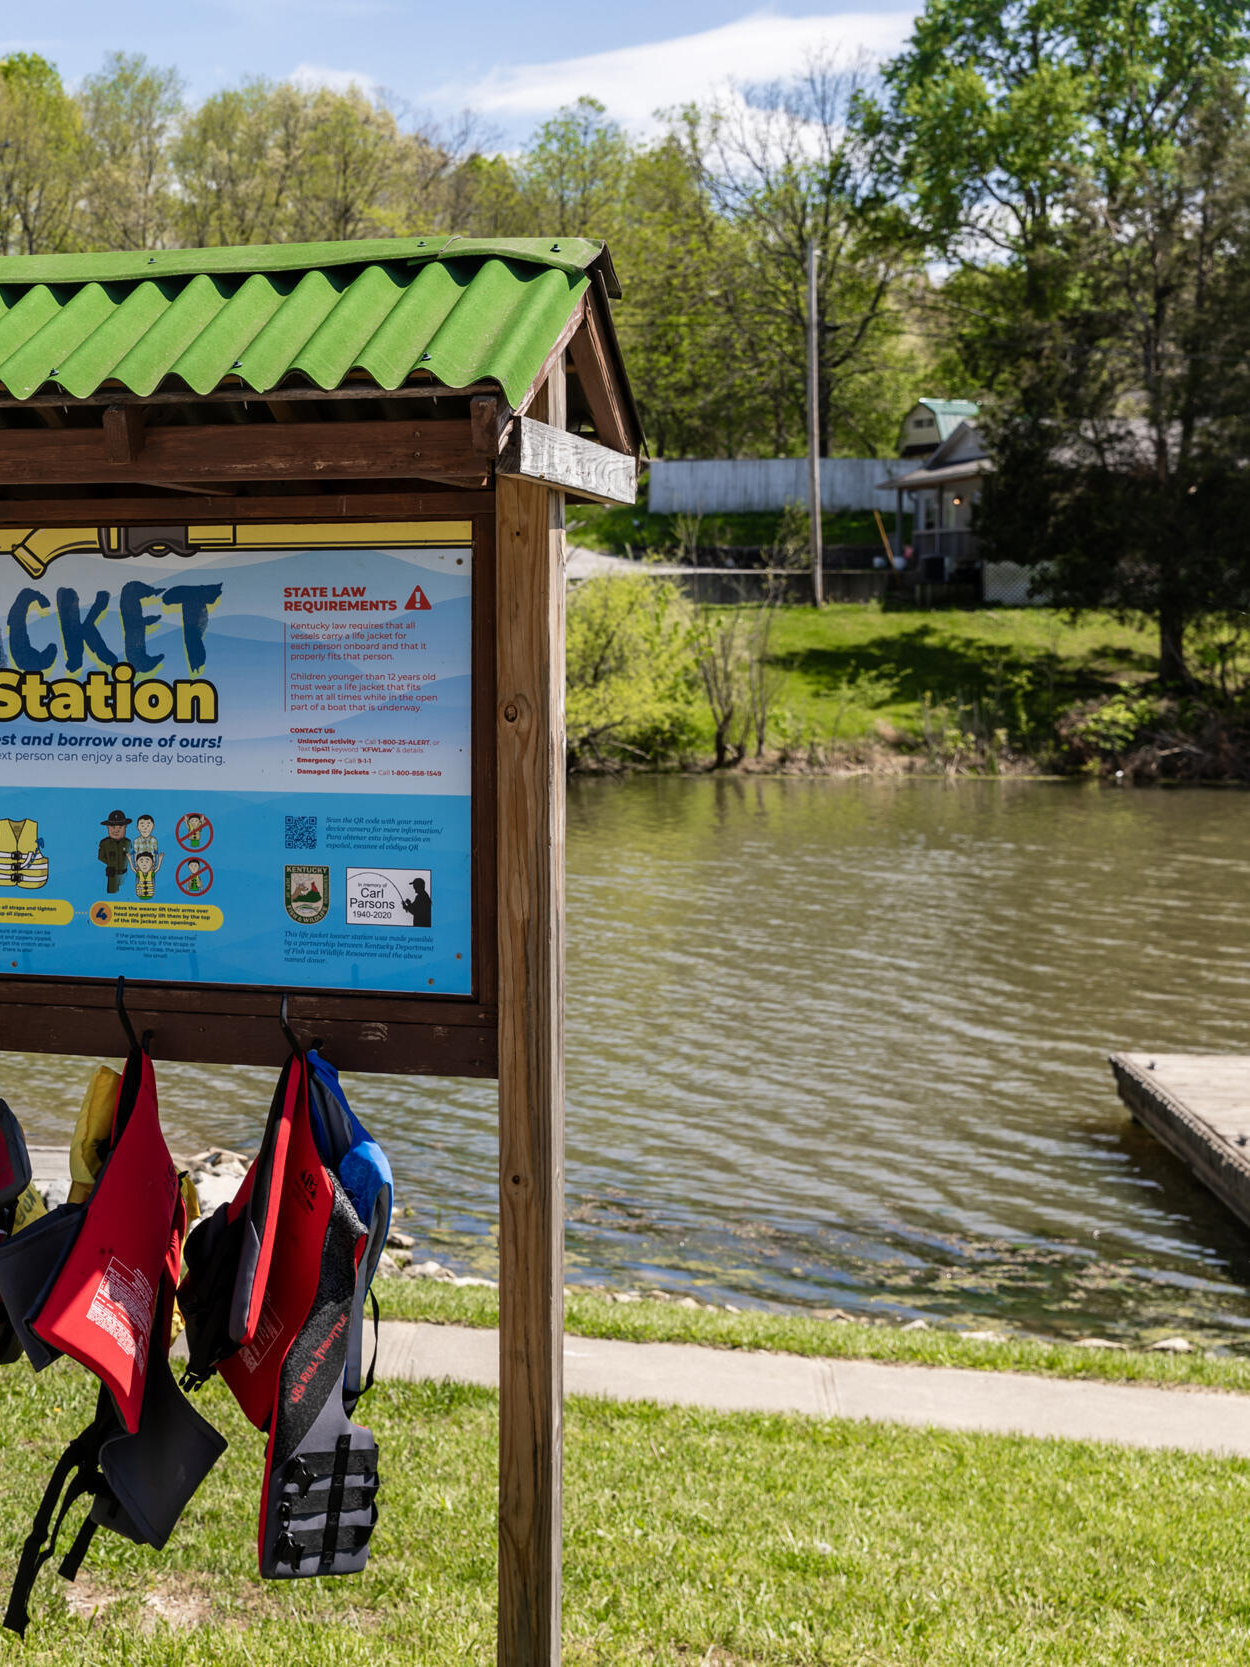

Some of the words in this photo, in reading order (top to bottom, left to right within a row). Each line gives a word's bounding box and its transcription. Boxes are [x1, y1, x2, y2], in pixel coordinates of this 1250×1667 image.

[284, 587, 328, 598] STATE
[332, 587, 366, 598] LAW
[284, 600, 397, 613] REQUIREMENTS
[290, 623, 330, 632] Kentucky
[332, 622, 347, 630] law
[348, 622, 384, 631] requires
[290, 632, 320, 640] vessels
[351, 632, 365, 640] life
[366, 632, 393, 641] jacket
[394, 632, 406, 640] for
[290, 642, 310, 650] each
[312, 644, 342, 652] person
[290, 653, 326, 662] properly
[290, 673, 326, 681] Children
[327, 675, 364, 683] younger
[365, 673, 386, 681] than
[387, 673, 396, 681] 12
[398, 675, 420, 683] years
[422, 673, 436, 681] old
[290, 683, 312, 691] must
[344, 683, 357, 691] life
[358, 683, 385, 693] jacket
[290, 693, 314, 701] them
[315, 693, 324, 701] at
[325, 693, 336, 701] all
[290, 703, 308, 713] part
[309, 703, 319, 711] of
[376, 704, 422, 713] underway.
[20, 733, 53, 745] and
[57, 734, 118, 746] borrow
[121, 737, 153, 747] one
[157, 735, 176, 747] of
[179, 735, 222, 748] ours!
[14, 753, 54, 763] person
[57, 753, 78, 761] can
[81, 752, 113, 764] enjoy
[115, 754, 122, 762] a
[125, 752, 149, 762] safe
[151, 753, 174, 765] day
[176, 753, 225, 766] boating.
[286, 866, 327, 874] KENTUCKY
[361, 887, 384, 899] Carl
[350, 897, 395, 910] Parsons
[95, 907, 108, 920] 4
[353, 910, 392, 919] 1940-2020
